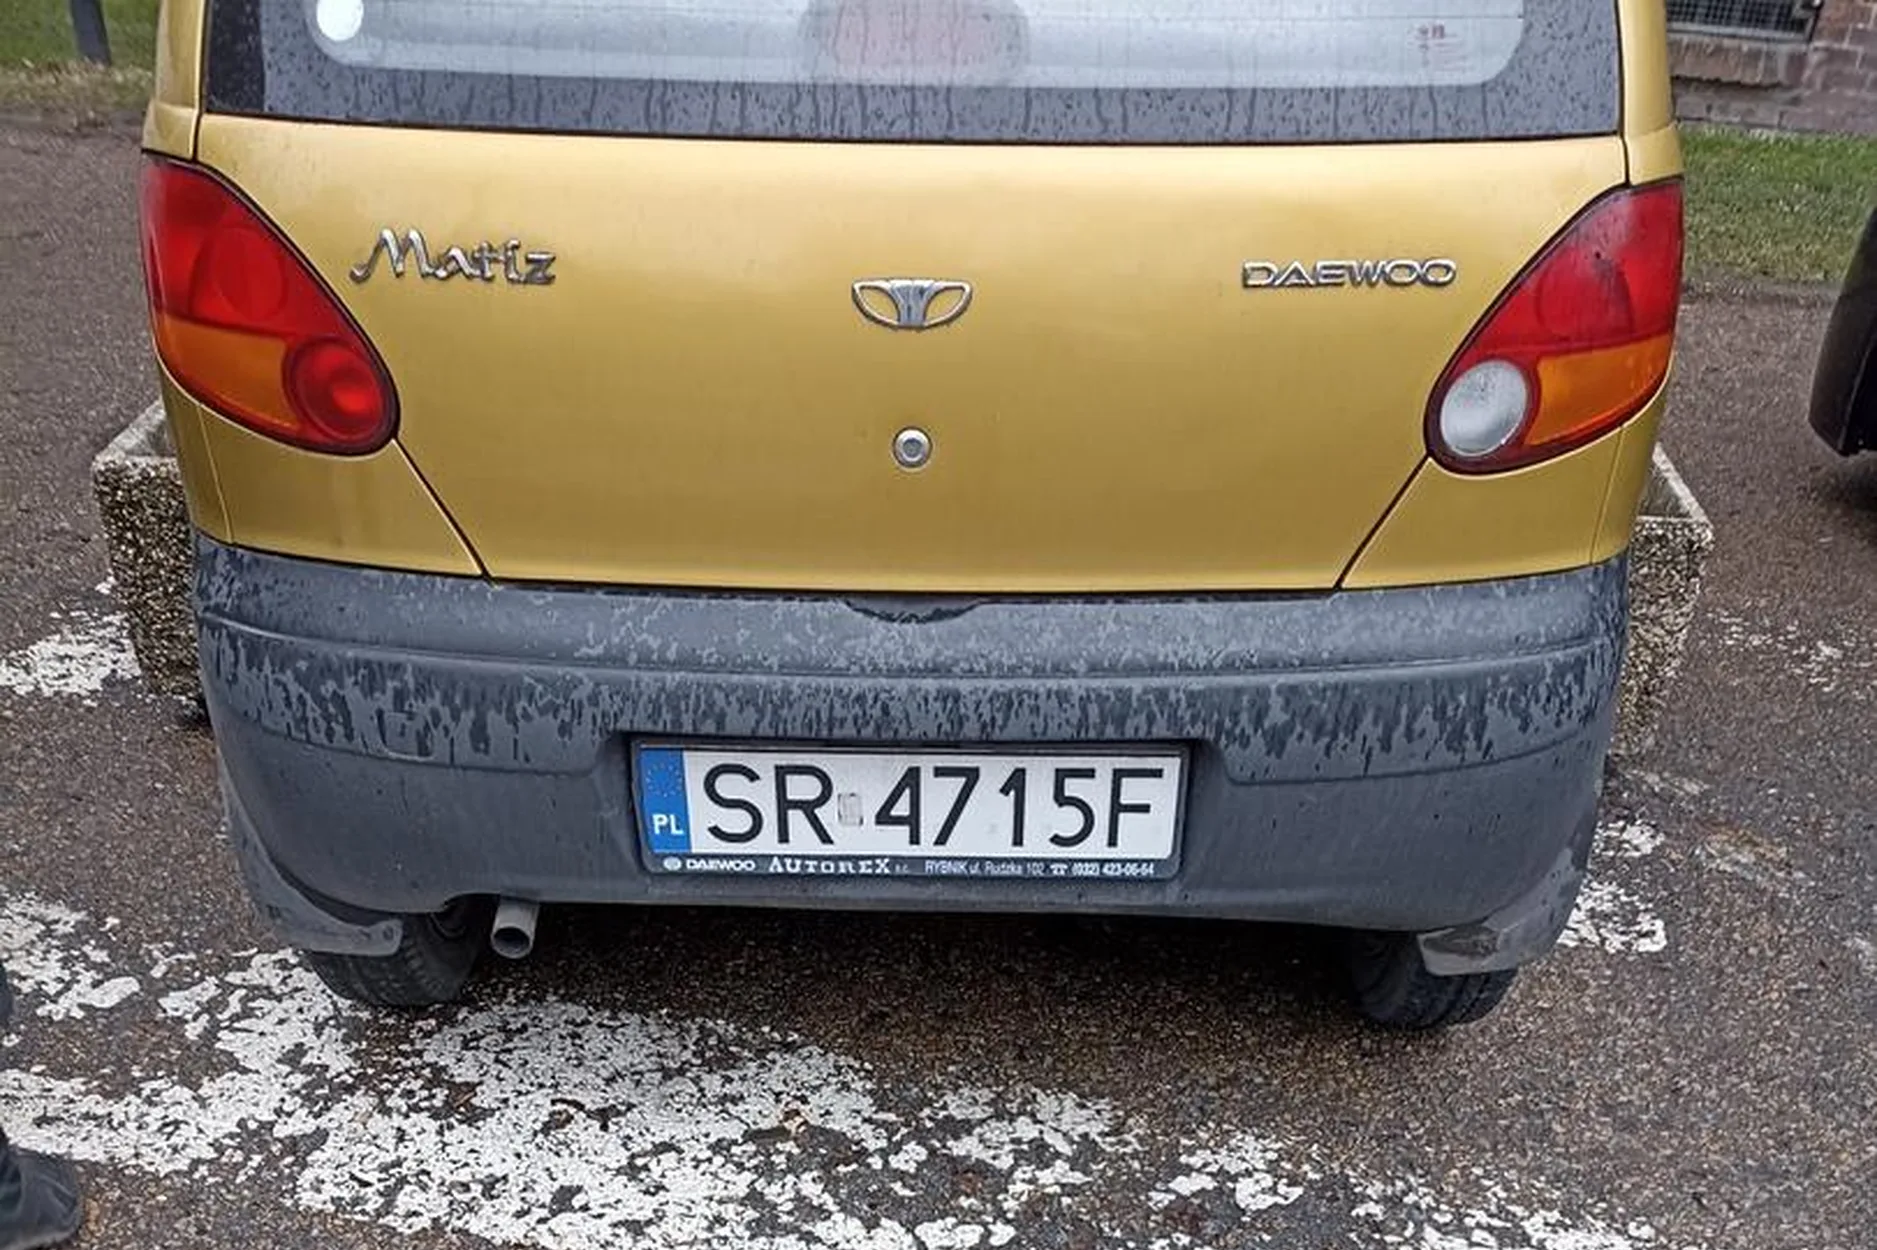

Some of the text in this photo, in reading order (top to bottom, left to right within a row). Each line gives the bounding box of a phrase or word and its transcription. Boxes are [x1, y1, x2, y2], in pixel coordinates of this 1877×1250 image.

[350, 227, 557, 284] Matiz
[1243, 260, 1456, 288] DAEWOO
[703, 763, 1164, 848] SR 4715F
[652, 814, 685, 835] PL
[686, 858, 756, 871] DAEWOO
[925, 860, 968, 874] RYBNIK
